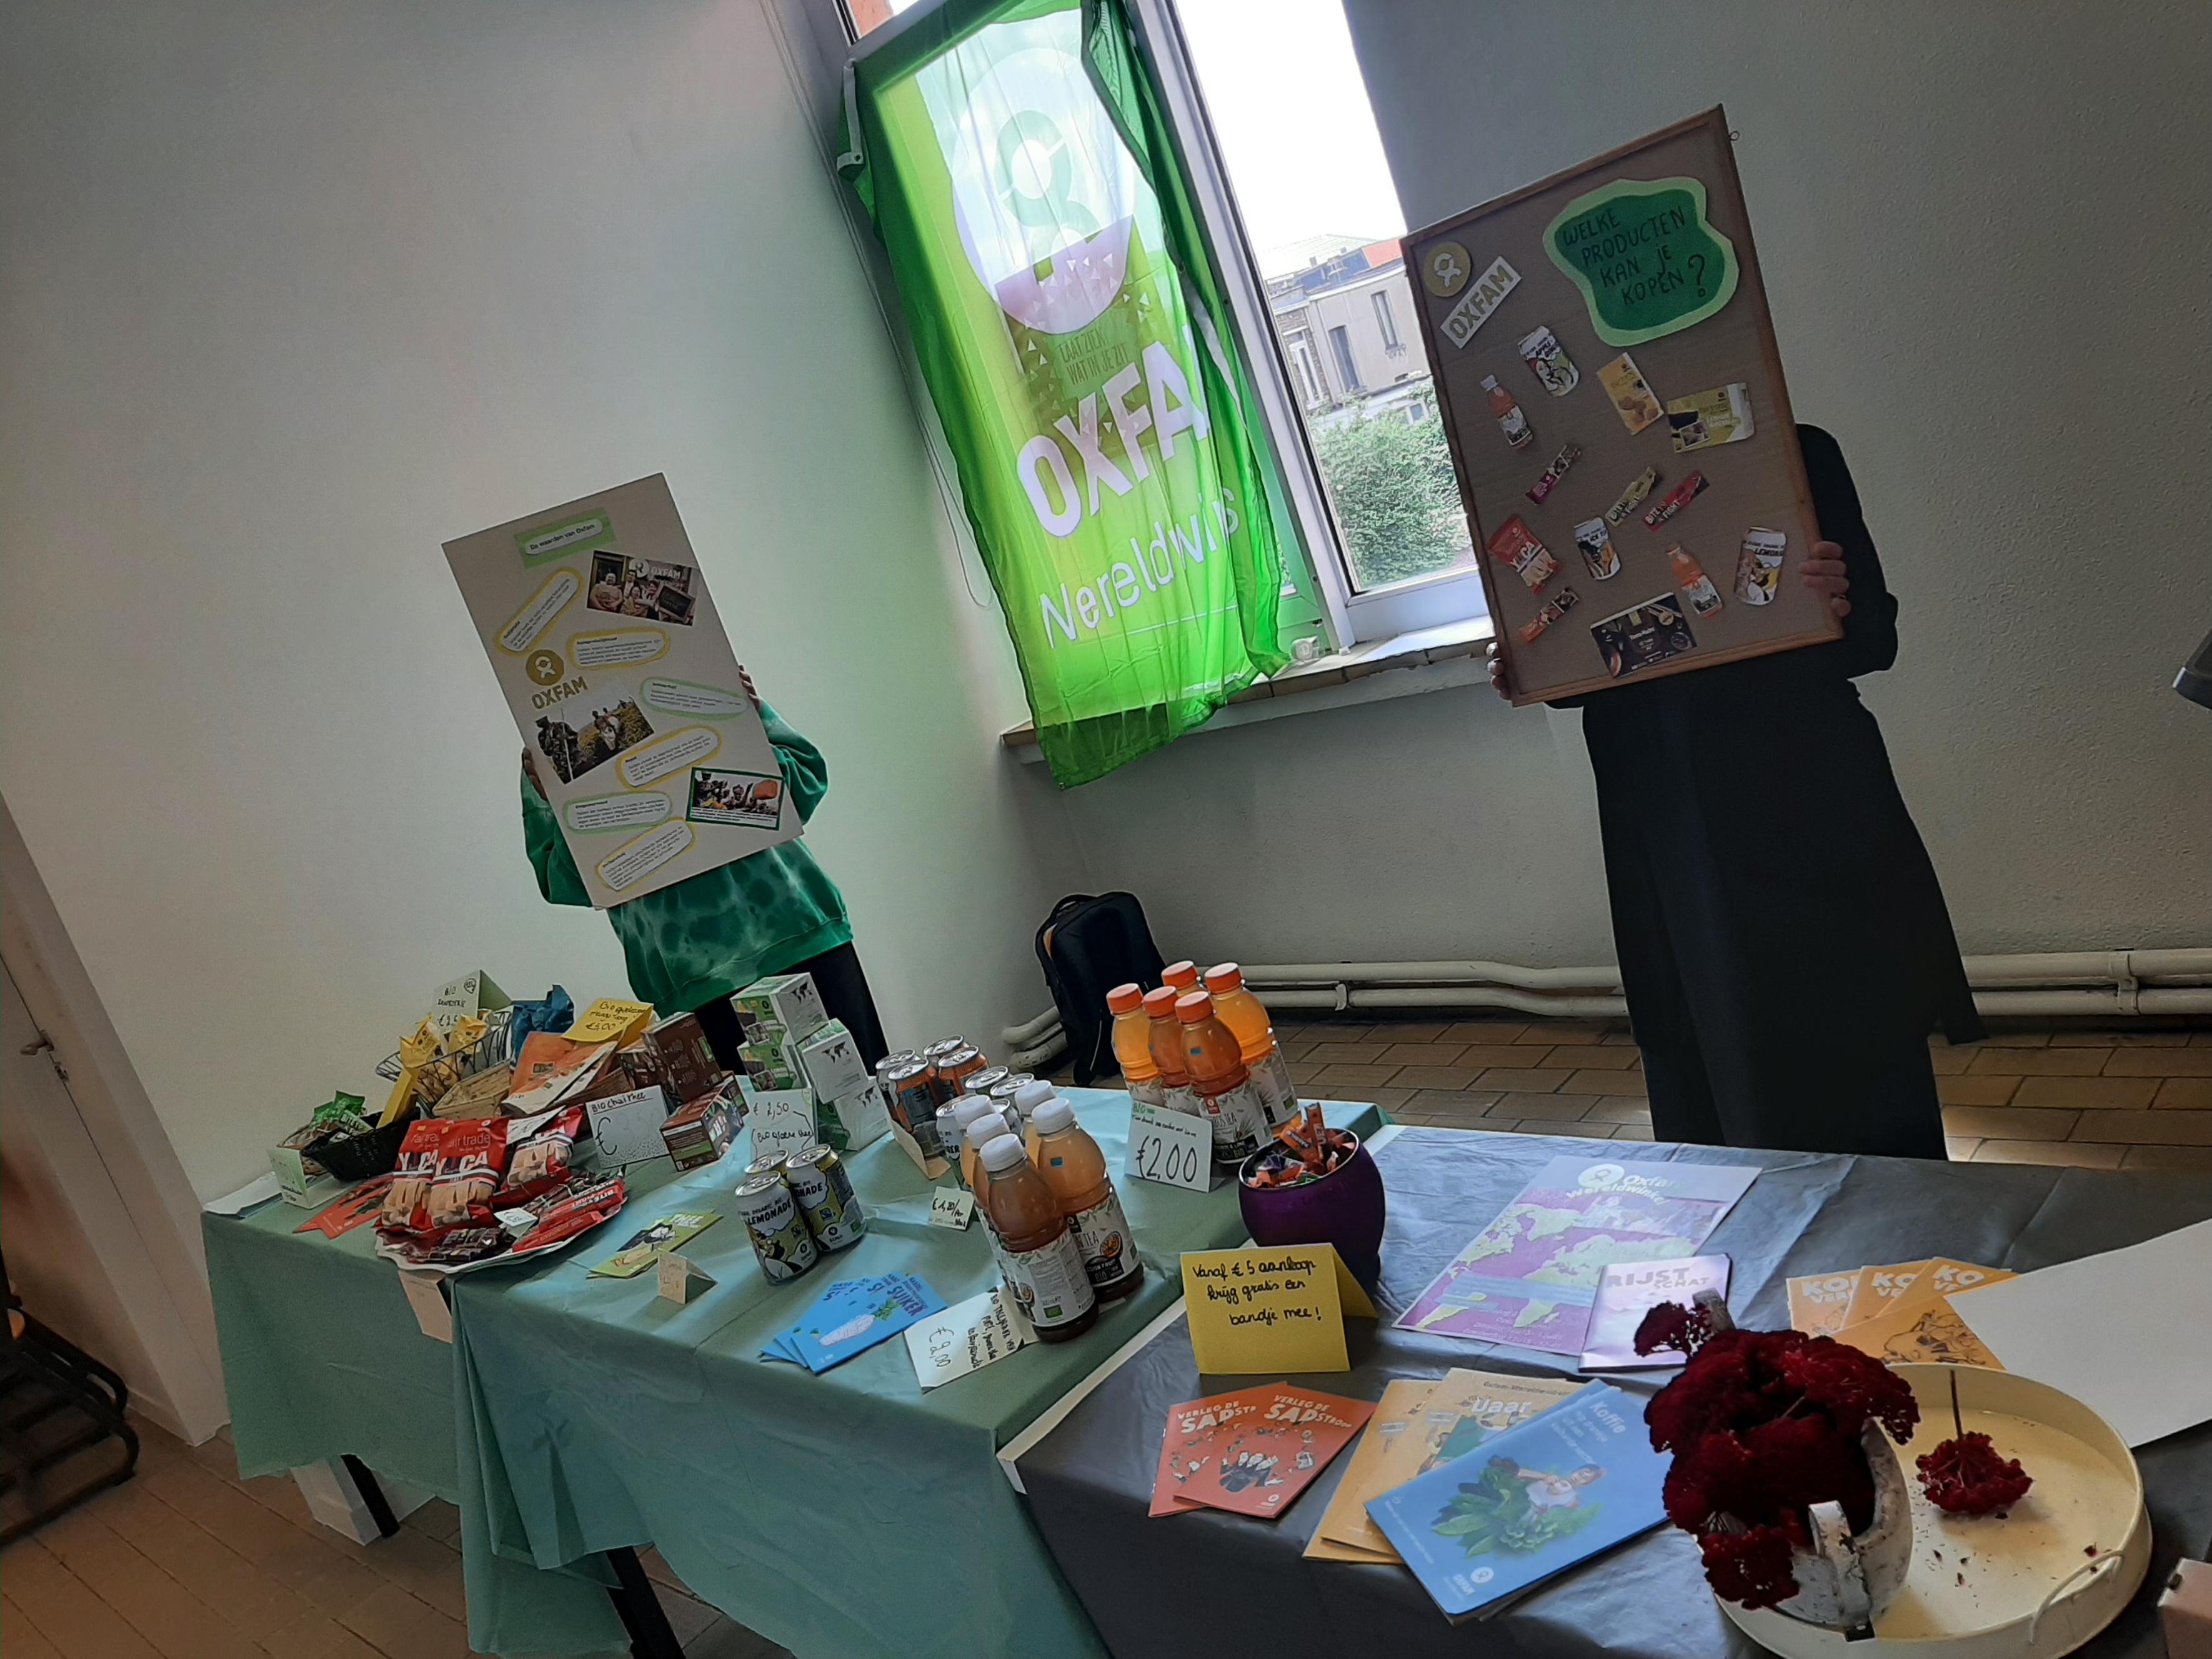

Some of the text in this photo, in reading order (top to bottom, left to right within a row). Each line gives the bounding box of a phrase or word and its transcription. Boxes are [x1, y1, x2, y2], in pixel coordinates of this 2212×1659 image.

[1562, 206, 1621, 247] WELKE
[1582, 206, 1686, 267] PRODUCTEN
[1599, 256, 1641, 288] KAN
[1622, 267, 1685, 305] KOPEN
[1447, 264, 1514, 340] OXFAM
[1066, 359, 1089, 386] WAT
[1017, 326, 1210, 537] OXFA
[1662, 499, 1681, 519] FIGHT
[531, 675, 589, 710] OXFAM
[463, 1132, 492, 1148] trade
[1135, 1134, 1198, 1183] €2,00
[746, 1197, 792, 1226] LEMONADE
[1082, 1230, 1100, 1247] TEA
[1192, 1256, 1317, 1282] Vanaf € 5 aankoop
[1606, 1267, 1691, 1288] RIJST
[1207, 1284, 1240, 1305] krijg
[1241, 1279, 1280, 1302] gratis
[1653, 1277, 1711, 1290] SCHAT
[1228, 1307, 1278, 1326] bandje
[1283, 1307, 1313, 1320] mee
[1177, 1400, 1240, 1420] VERLEG DE
[1273, 1394, 1330, 1412] VERLEG DE
[1589, 1401, 1627, 1435] Koffie
